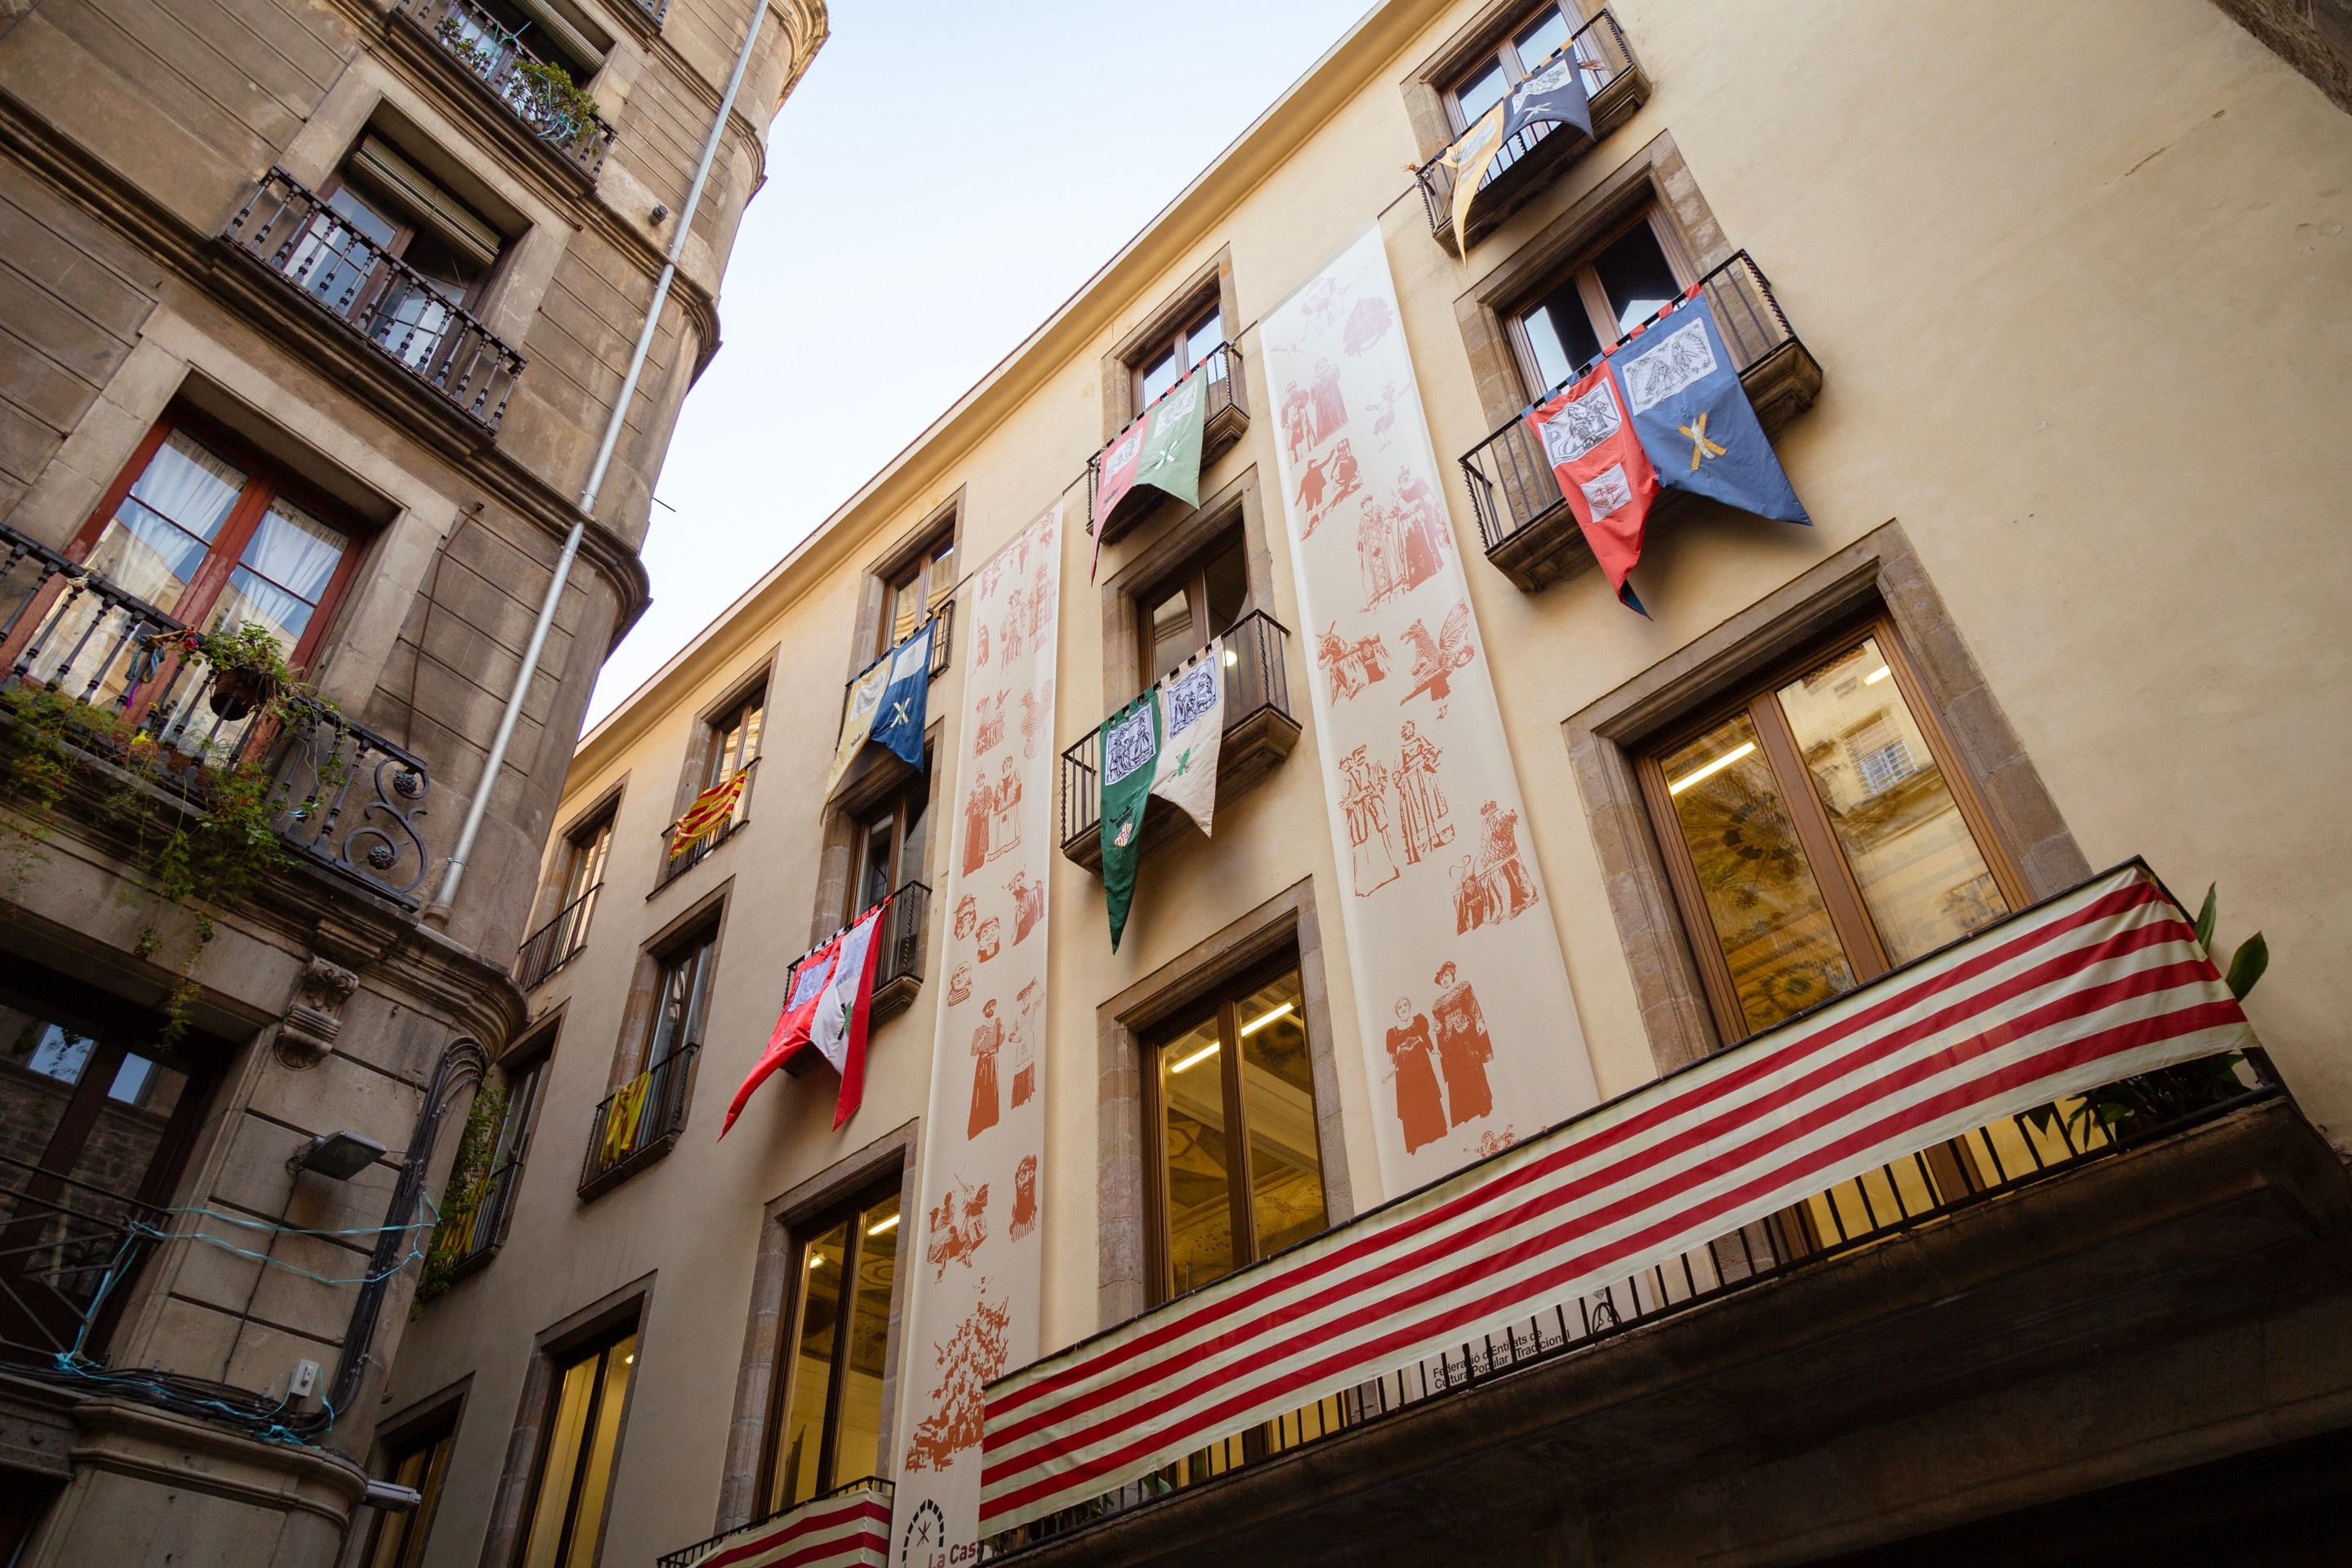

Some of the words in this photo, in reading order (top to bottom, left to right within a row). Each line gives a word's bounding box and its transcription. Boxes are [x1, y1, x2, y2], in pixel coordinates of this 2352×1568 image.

[1433, 1352, 1480, 1379] Federaió
[1482, 1335, 1528, 1360] dEntiats
[1435, 1371, 1468, 1389] Cutura
[1516, 1330, 1570, 1358] Tradcionl
[928, 1552, 946, 1568] La
[950, 1542, 978, 1565] Cas
